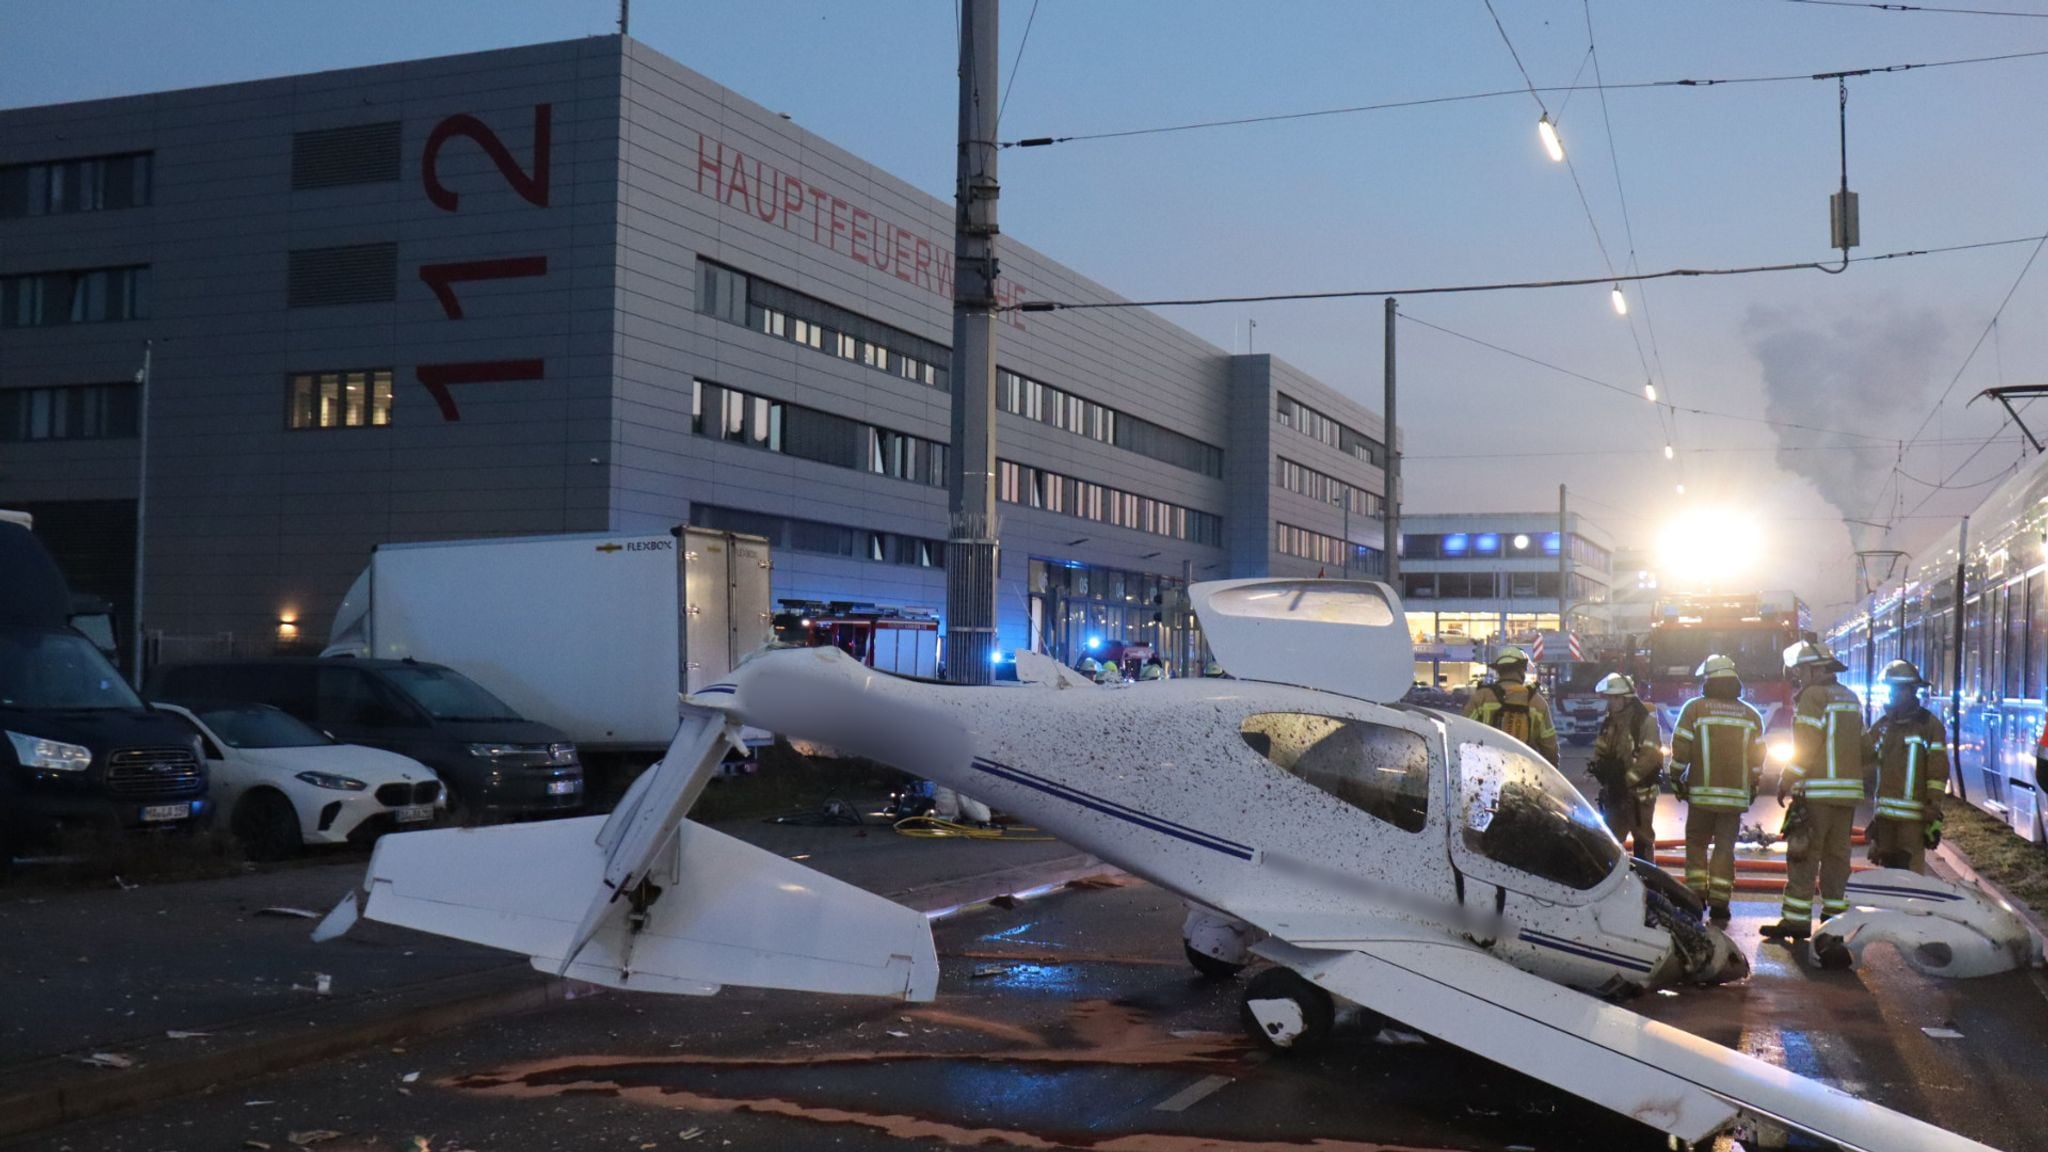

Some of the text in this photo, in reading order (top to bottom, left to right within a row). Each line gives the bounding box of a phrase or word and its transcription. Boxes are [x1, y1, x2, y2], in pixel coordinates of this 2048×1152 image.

[415, 103, 551, 421] 112
[697, 135, 1026, 330] HAUPTFEUERWHE
[627, 541, 672, 551] FLEXBOX
